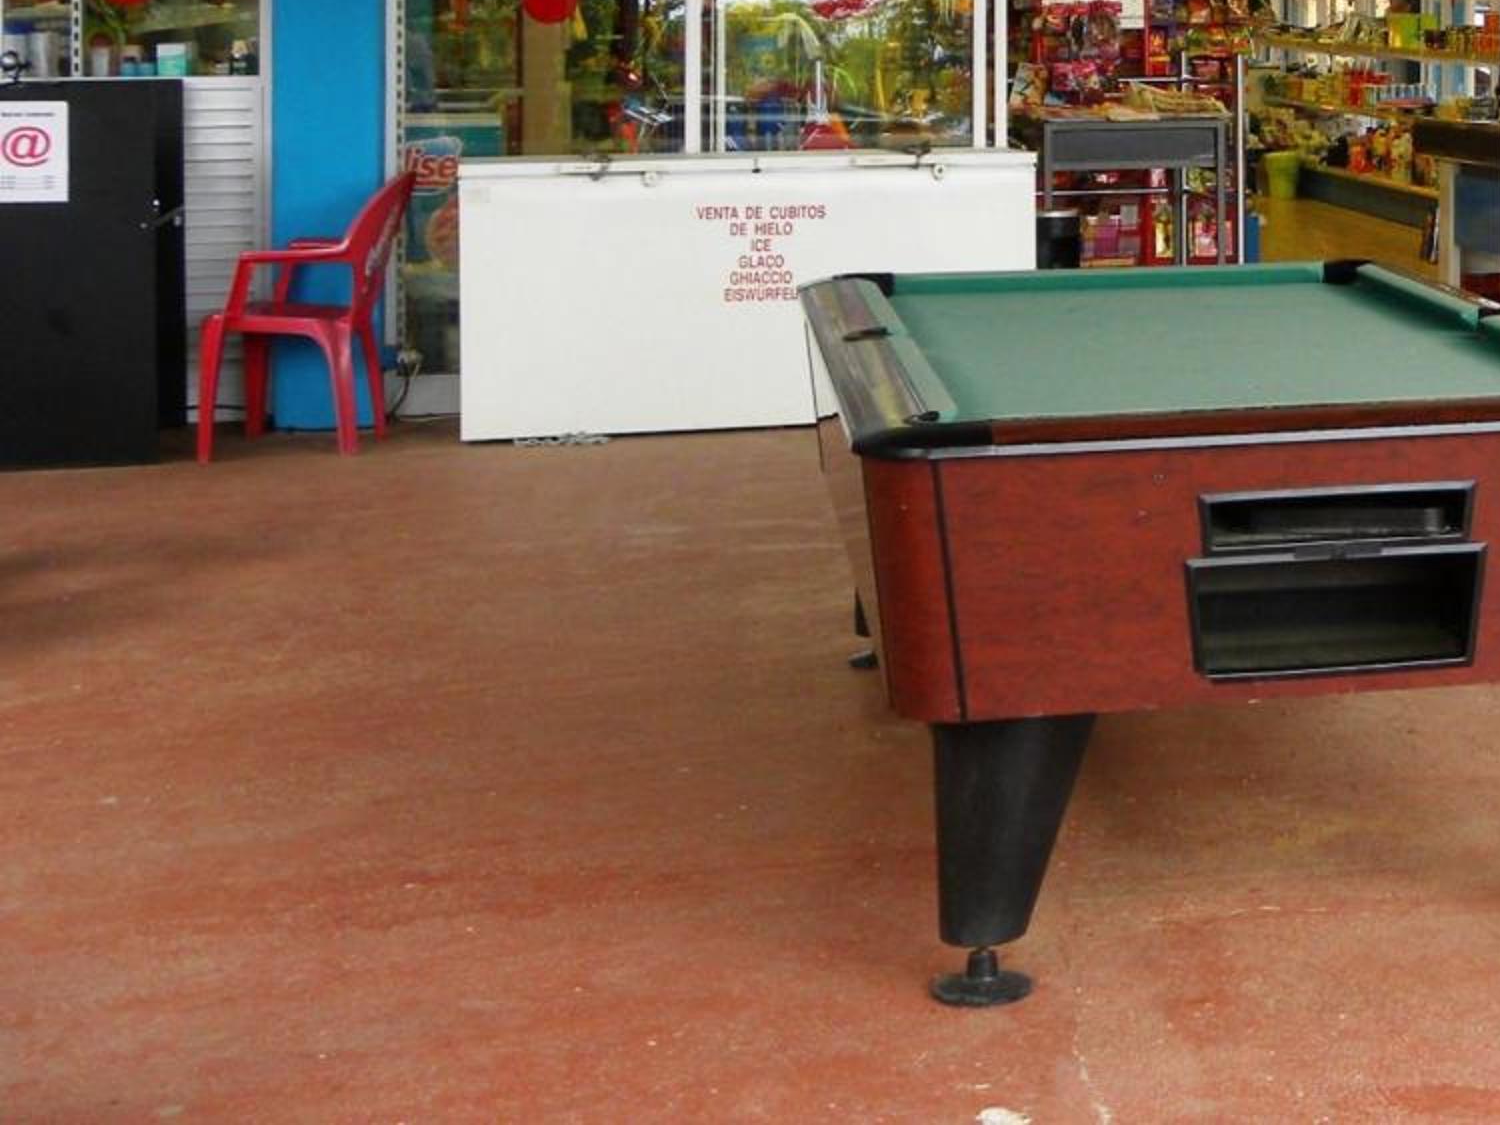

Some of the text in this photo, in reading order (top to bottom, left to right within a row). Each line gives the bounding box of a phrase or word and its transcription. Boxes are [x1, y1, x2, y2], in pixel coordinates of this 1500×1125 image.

[696, 205, 827, 220] VENTA DE CUBITOS
[729, 221, 793, 236] DE HIELO
[751, 239, 772, 252] ICE
[729, 271, 793, 285] GHIACCIO
